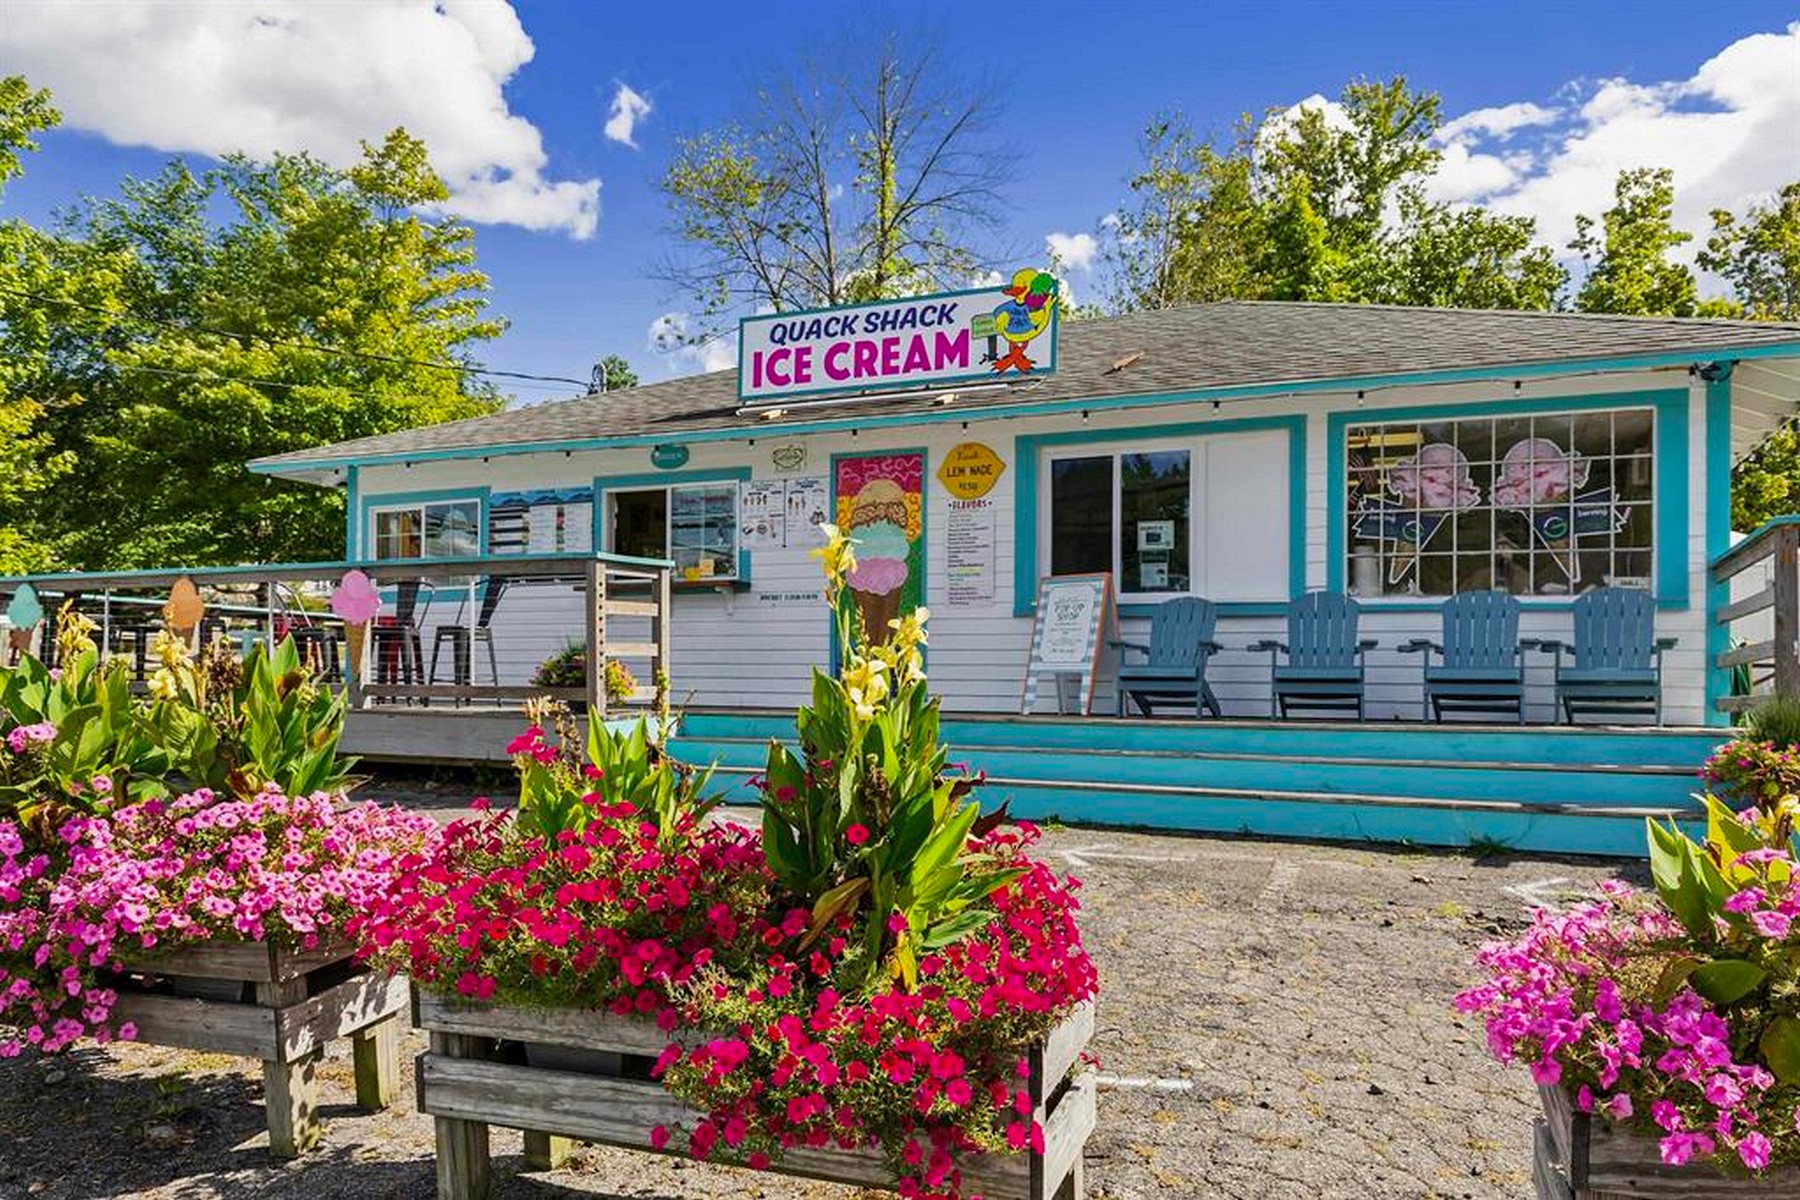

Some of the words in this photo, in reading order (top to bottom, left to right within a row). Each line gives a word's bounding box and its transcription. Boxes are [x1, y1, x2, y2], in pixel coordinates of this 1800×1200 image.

[769, 315, 860, 346] QUACK
[863, 302, 959, 333] SHACK
[752, 347, 813, 388] ICE
[823, 328, 970, 381] CREAM
[946, 464, 992, 478] LEMNADE
[952, 500, 987, 510] FLAVORS
